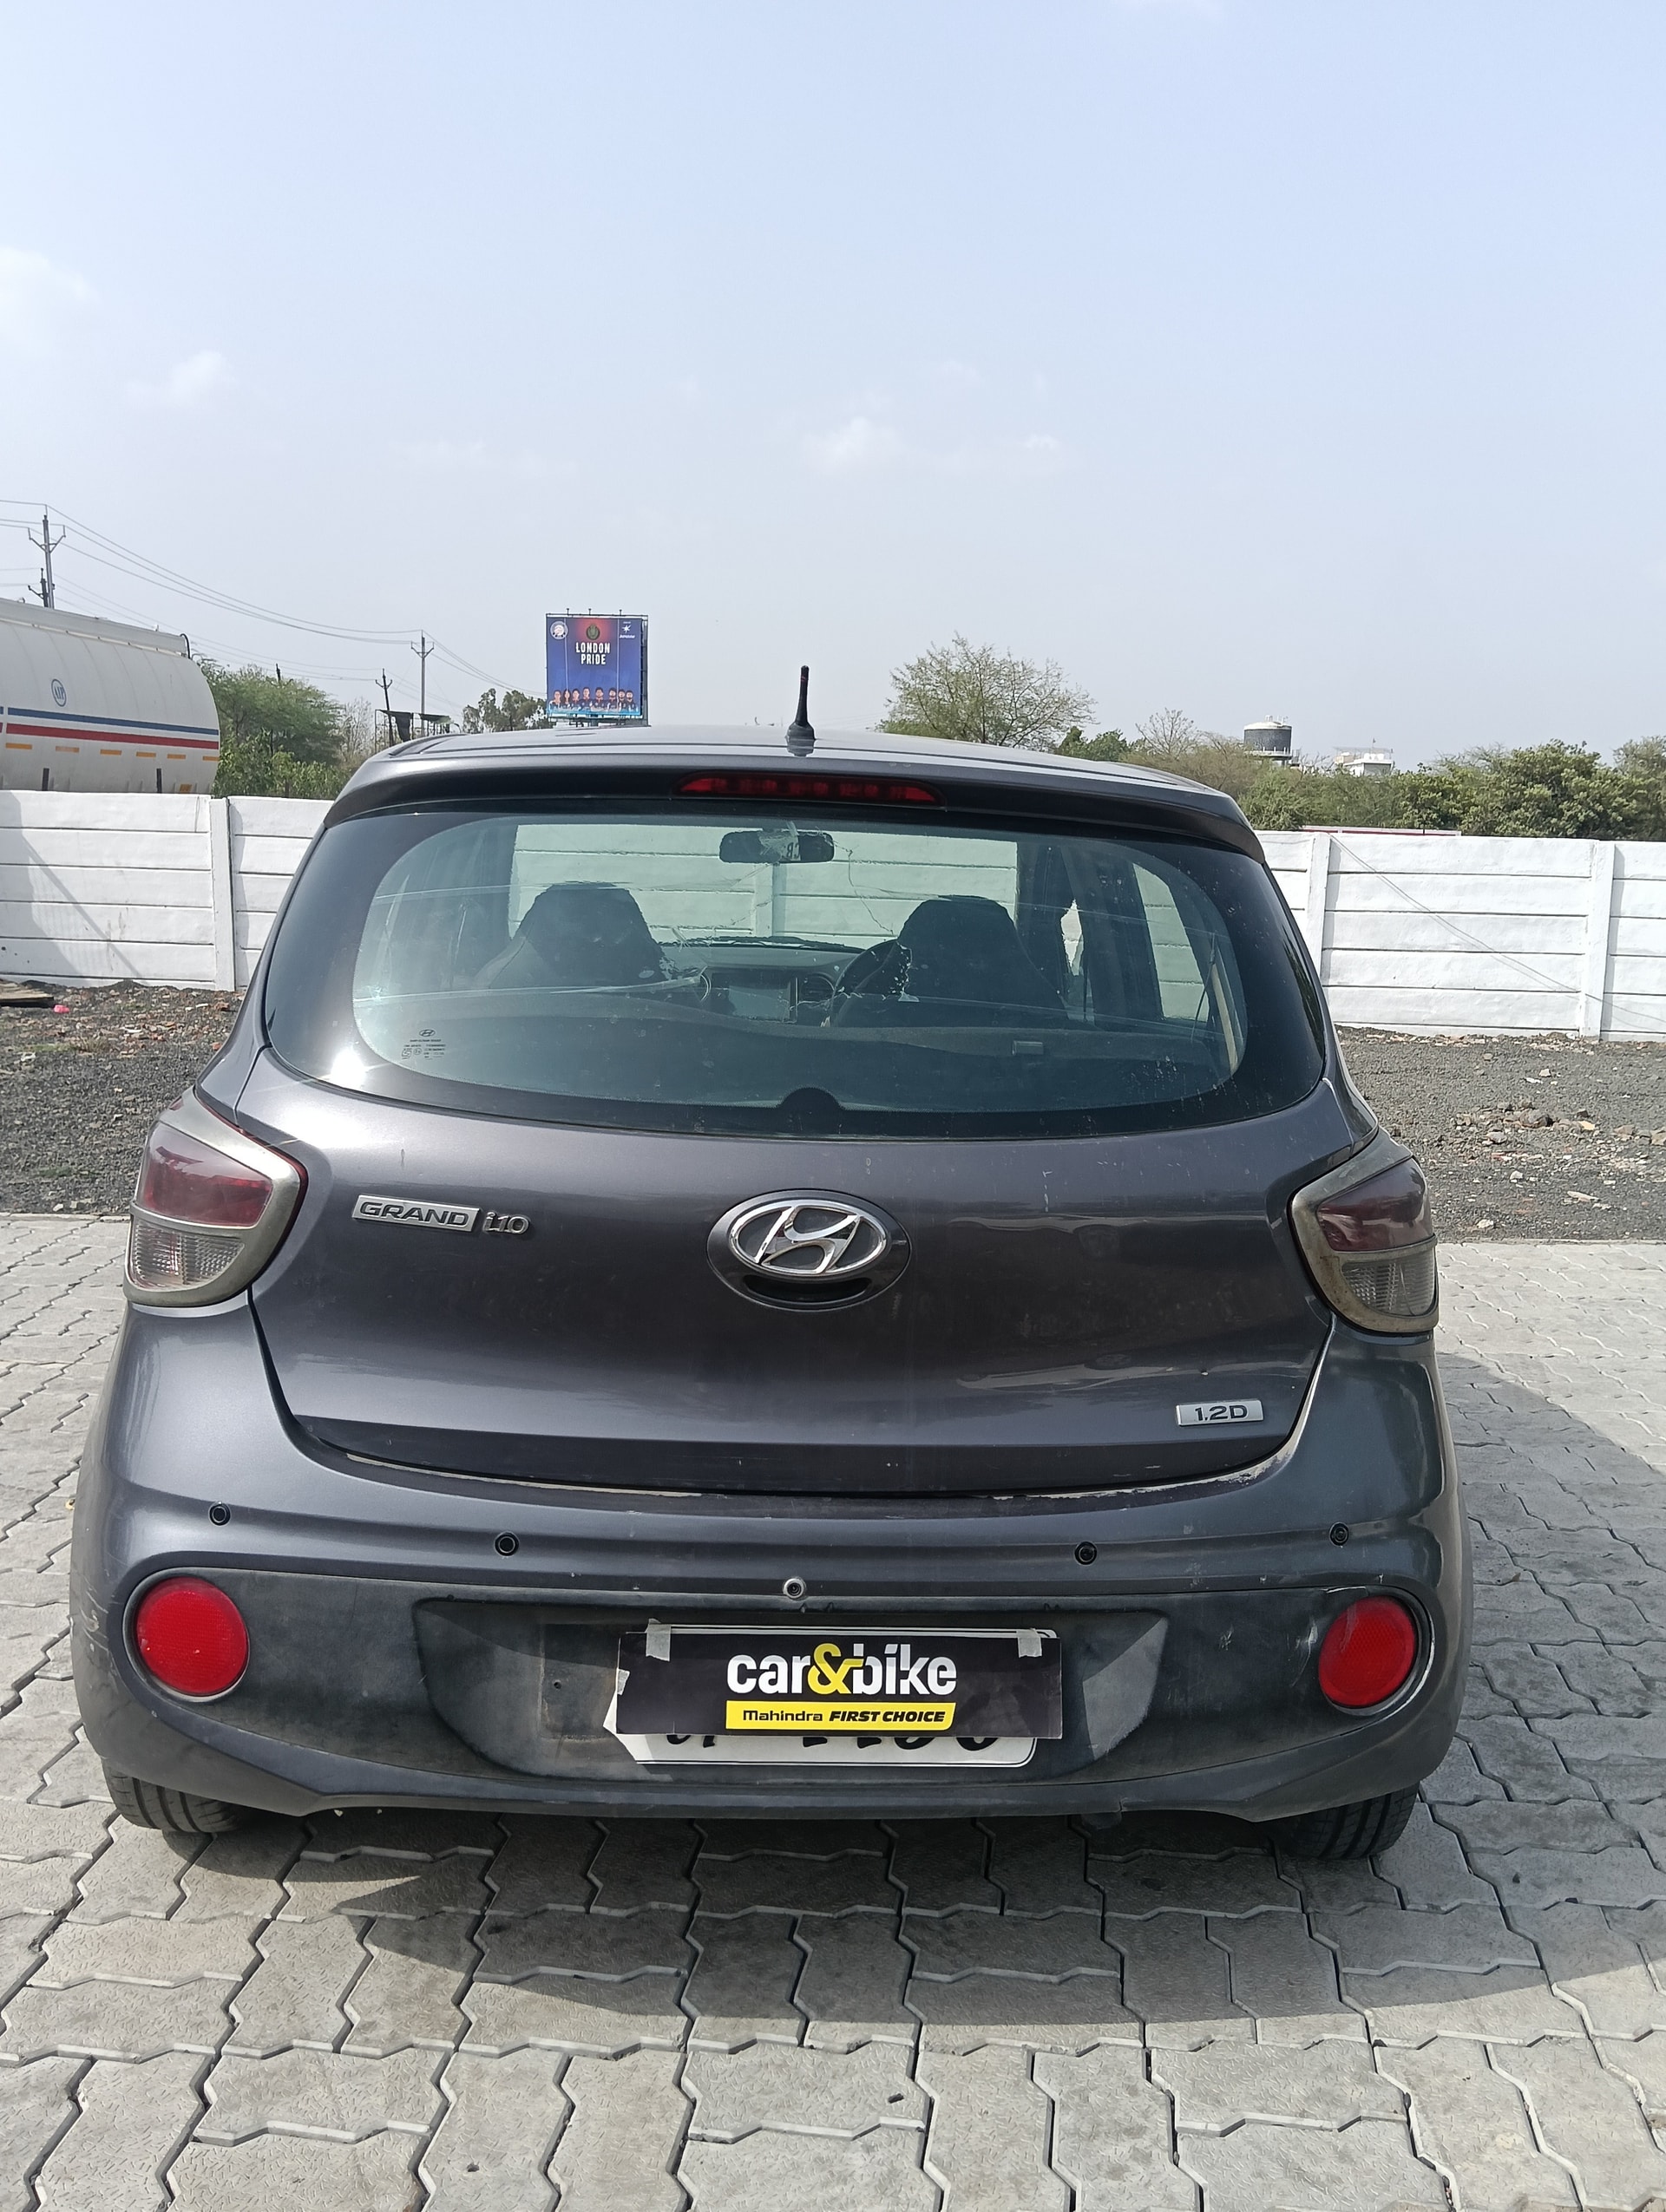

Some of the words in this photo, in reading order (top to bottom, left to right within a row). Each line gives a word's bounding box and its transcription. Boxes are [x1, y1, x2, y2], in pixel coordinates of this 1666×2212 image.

[575, 642, 611, 653] LONDON
[580, 653, 607, 665] PRIDE
[359, 1201, 469, 1227] GRAND
[482, 1211, 529, 1234] i10
[1195, 1404, 1248, 1421] 1.2D
[727, 1643, 957, 1695] car&bike
[743, 1710, 823, 1722] Mahindra
[829, 1711, 881, 1722] FIRST
[882, 1711, 946, 1723] CHOICE
